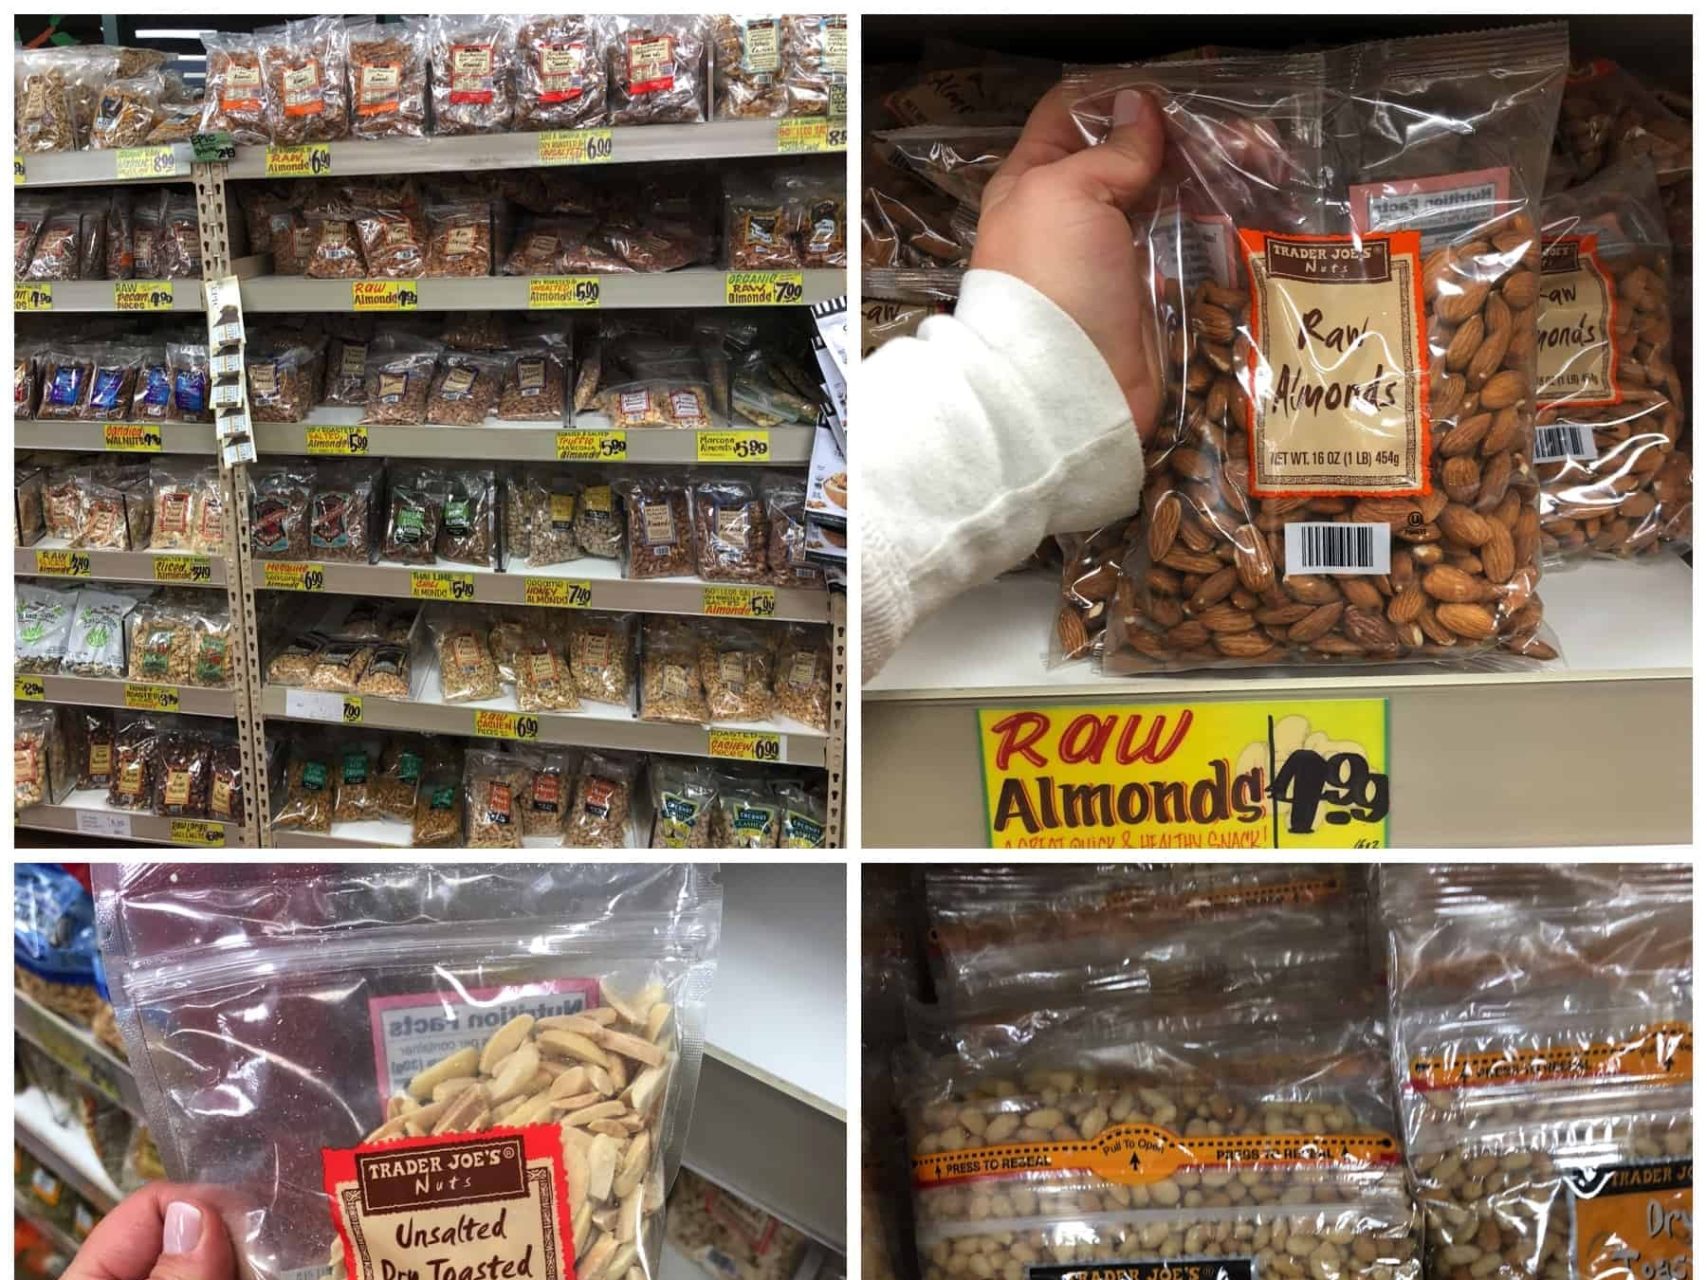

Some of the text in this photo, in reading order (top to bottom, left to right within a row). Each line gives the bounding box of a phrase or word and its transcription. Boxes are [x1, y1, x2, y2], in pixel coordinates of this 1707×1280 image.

[1273, 245, 1328, 260] TRADER
[1305, 261, 1348, 273] Nuts
[1298, 308, 1369, 352] Raw
[1272, 363, 1398, 418] Almonds
[1291, 451, 1310, 465] WT.
[1313, 451, 1324, 464] 16
[1327, 451, 1341, 465] OZ
[1343, 452, 1353, 467] (1
[1356, 452, 1372, 466] LB)
[1375, 451, 1400, 467] 454g
[993, 758, 1264, 834] Almonds
[1139, 831, 1201, 849] HEALTHY
[1103, 1139, 1165, 1157] Pull To Open
[369, 1149, 501, 1180] TRADER JOE'S
[946, 1156, 1053, 1175] PRESS TO RESEAL
[415, 1173, 472, 1195] Nuts
[1612, 1166, 1672, 1187] TRADER
[396, 1207, 508, 1249] Unsalted
